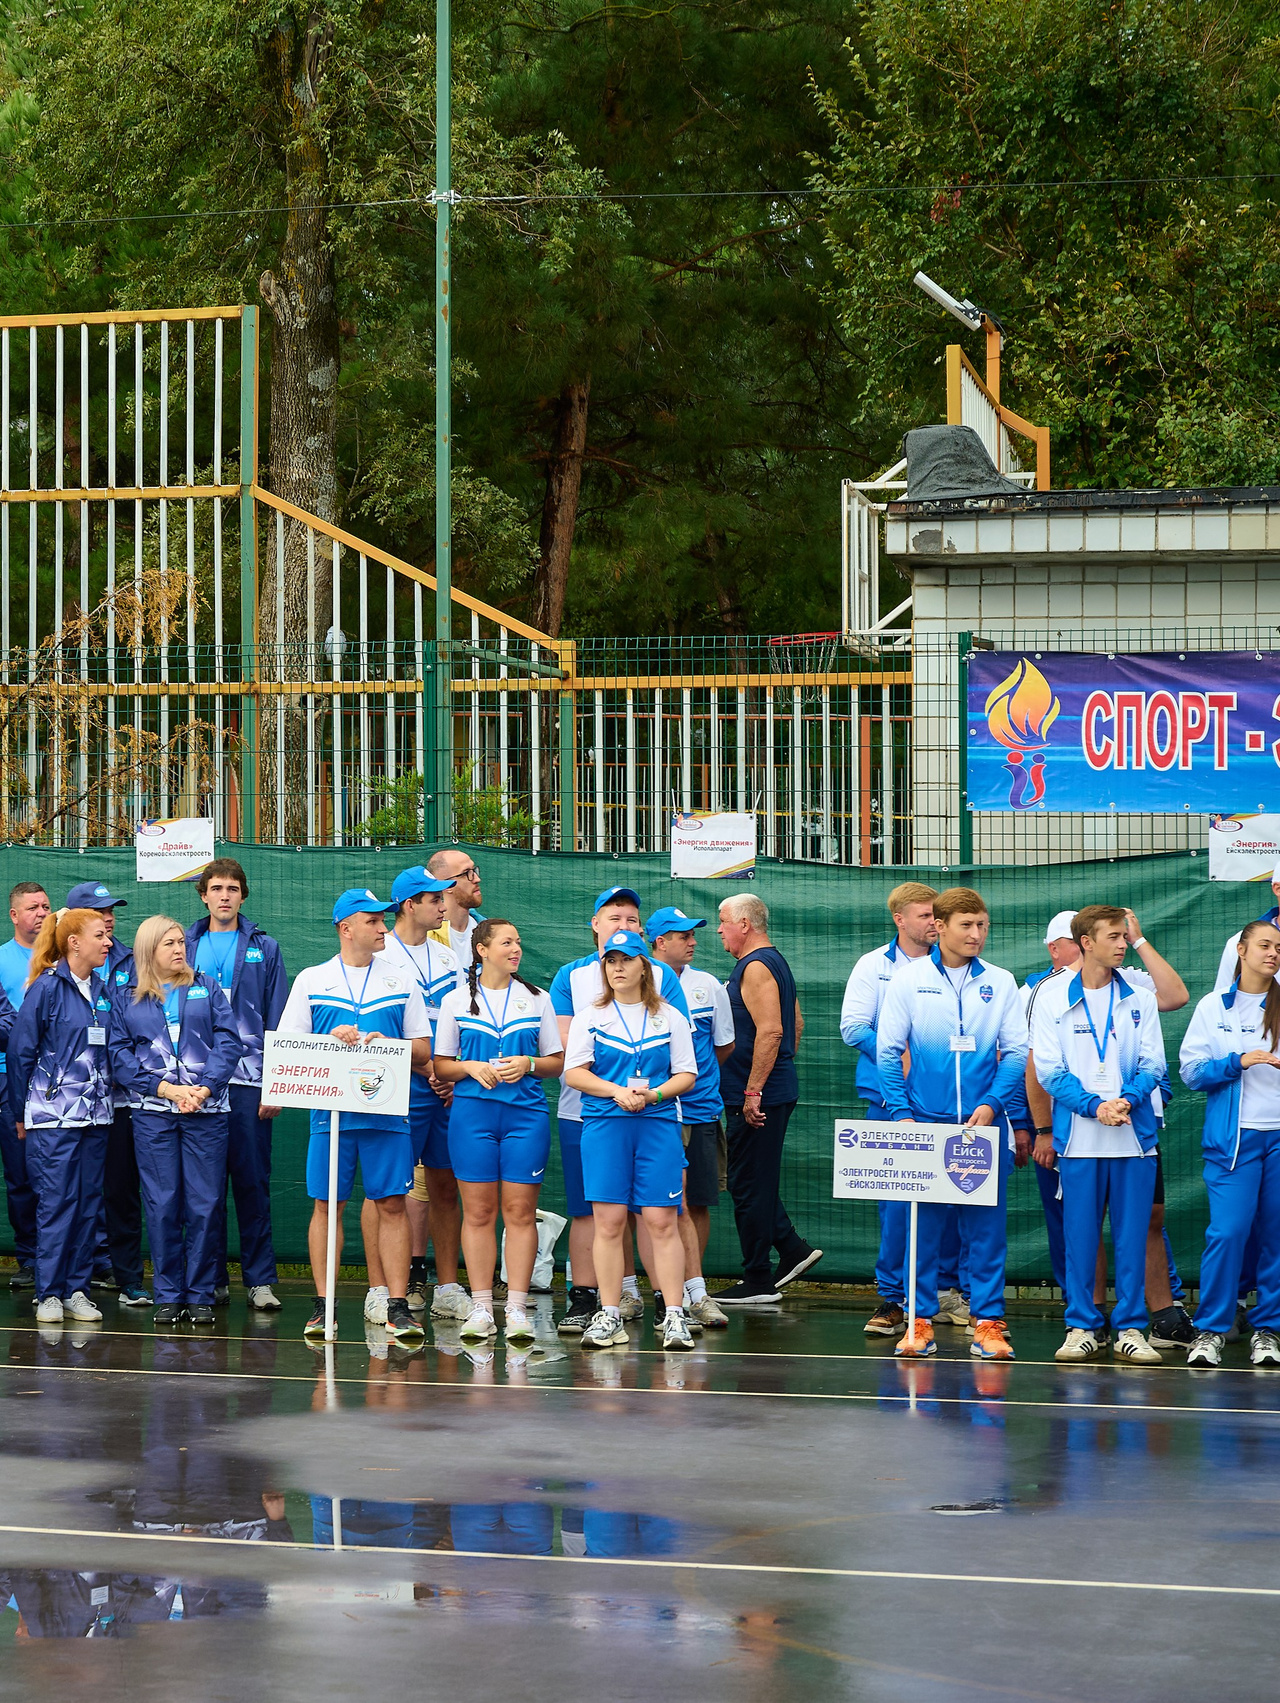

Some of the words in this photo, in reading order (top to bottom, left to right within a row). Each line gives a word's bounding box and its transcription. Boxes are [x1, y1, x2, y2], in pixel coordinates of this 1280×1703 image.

[1082, 690, 1237, 771] СПОРТ
[157, 842, 193, 851] «Драйв»
[673, 838, 708, 847] «Энергия
[1231, 839, 1277, 849] «Энергия»
[138, 850, 212, 858] Кореновскэлектросеть
[245, 950, 262, 959] RIVE
[187, 988, 206, 996] RIVE
[273, 1039, 362, 1054] ИСПОЛНИТЕЛЬНЫЙ
[363, 1045, 405, 1056] АППАРАТ
[271, 1064, 330, 1079] «ЭНЕРГИЯ
[269, 1082, 344, 1097] ДВИЖЕНИЯ»
[861, 1131, 935, 1142] ЭЛЕКТРОСЕТИ
[861, 1142, 934, 1151] КУБАНИ
[883, 1157, 894, 1166] АО
[839, 1168, 899, 1178] «ЭЛЕКТРОСЕТИ
[901, 1170, 938, 1180] КУБАНИ»
[845, 1179, 930, 1192] «ЕЙСКЭЛЕКТРОСЕТЬ»
